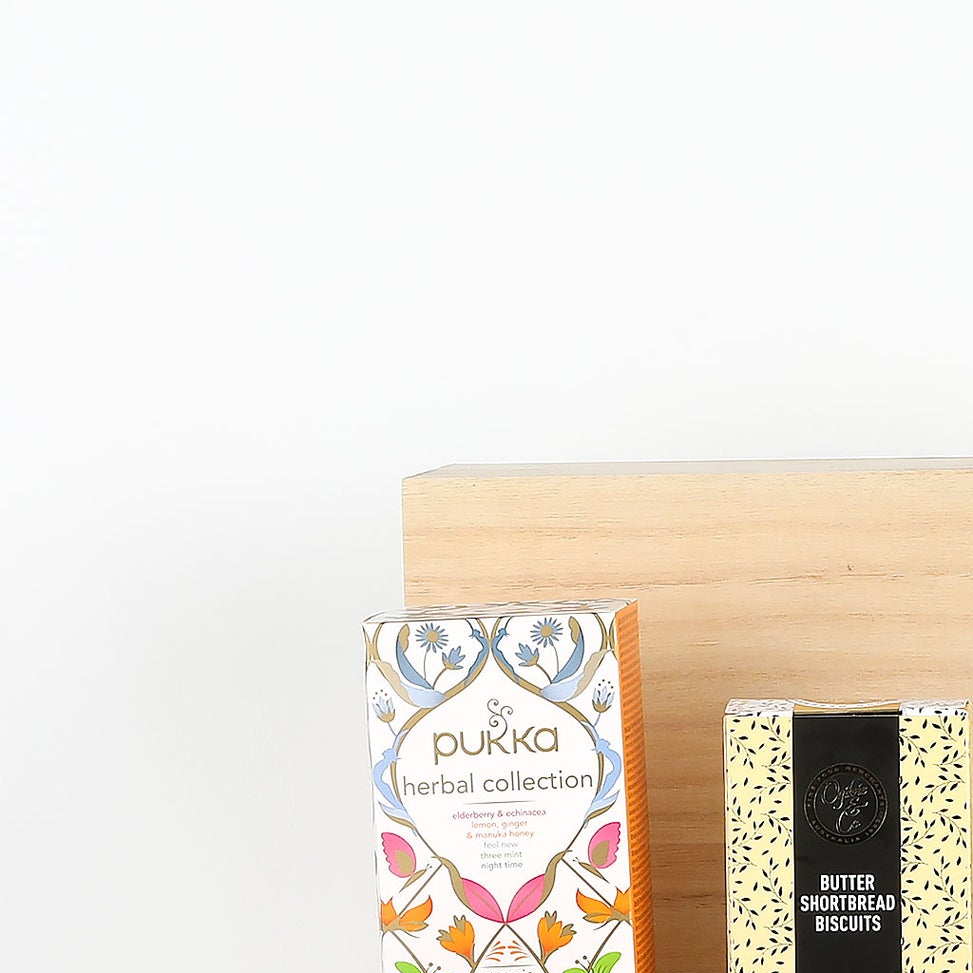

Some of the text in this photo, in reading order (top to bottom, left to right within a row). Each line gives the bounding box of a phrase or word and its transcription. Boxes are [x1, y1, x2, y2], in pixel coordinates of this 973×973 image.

[433, 716, 559, 765] pukka
[403, 770, 594, 796] herbal collection
[452, 808, 547, 820] elderberry & echinacea
[471, 820, 528, 829] lemon, ginger
[475, 831, 507, 839] manuka
[509, 830, 534, 839] honey
[483, 841, 499, 849] feel
[481, 860, 523, 871] night time
[820, 874, 875, 891] BUTTER
[800, 894, 896, 912] SHORTBREAD
[815, 915, 881, 932] BISCUITS
